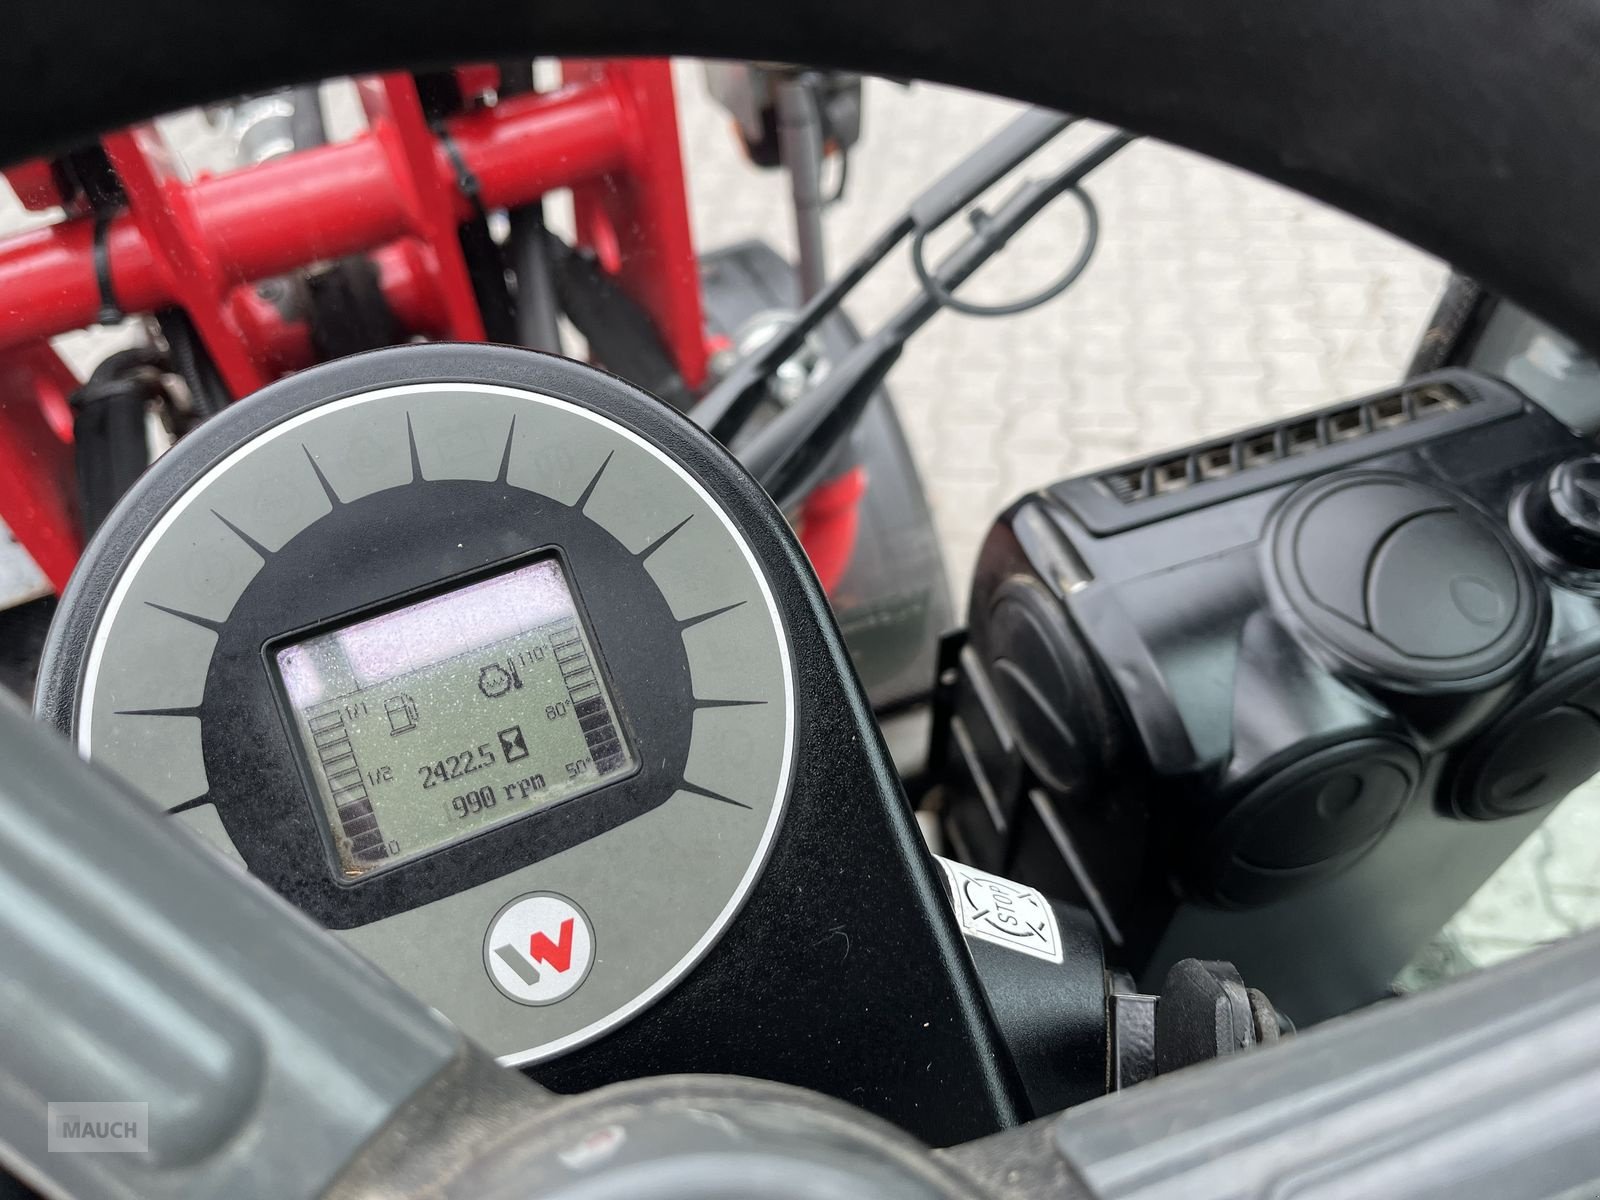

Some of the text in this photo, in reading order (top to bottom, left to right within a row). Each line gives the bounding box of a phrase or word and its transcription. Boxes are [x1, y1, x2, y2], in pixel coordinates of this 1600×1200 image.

[344, 703, 368, 720] 1/1
[367, 766, 394, 786] 1/2
[419, 743, 495, 789] 2422.5
[452, 773, 546, 819] 990 rpm
[389, 840, 400, 855] 0
[989, 885, 1018, 926] STOP
